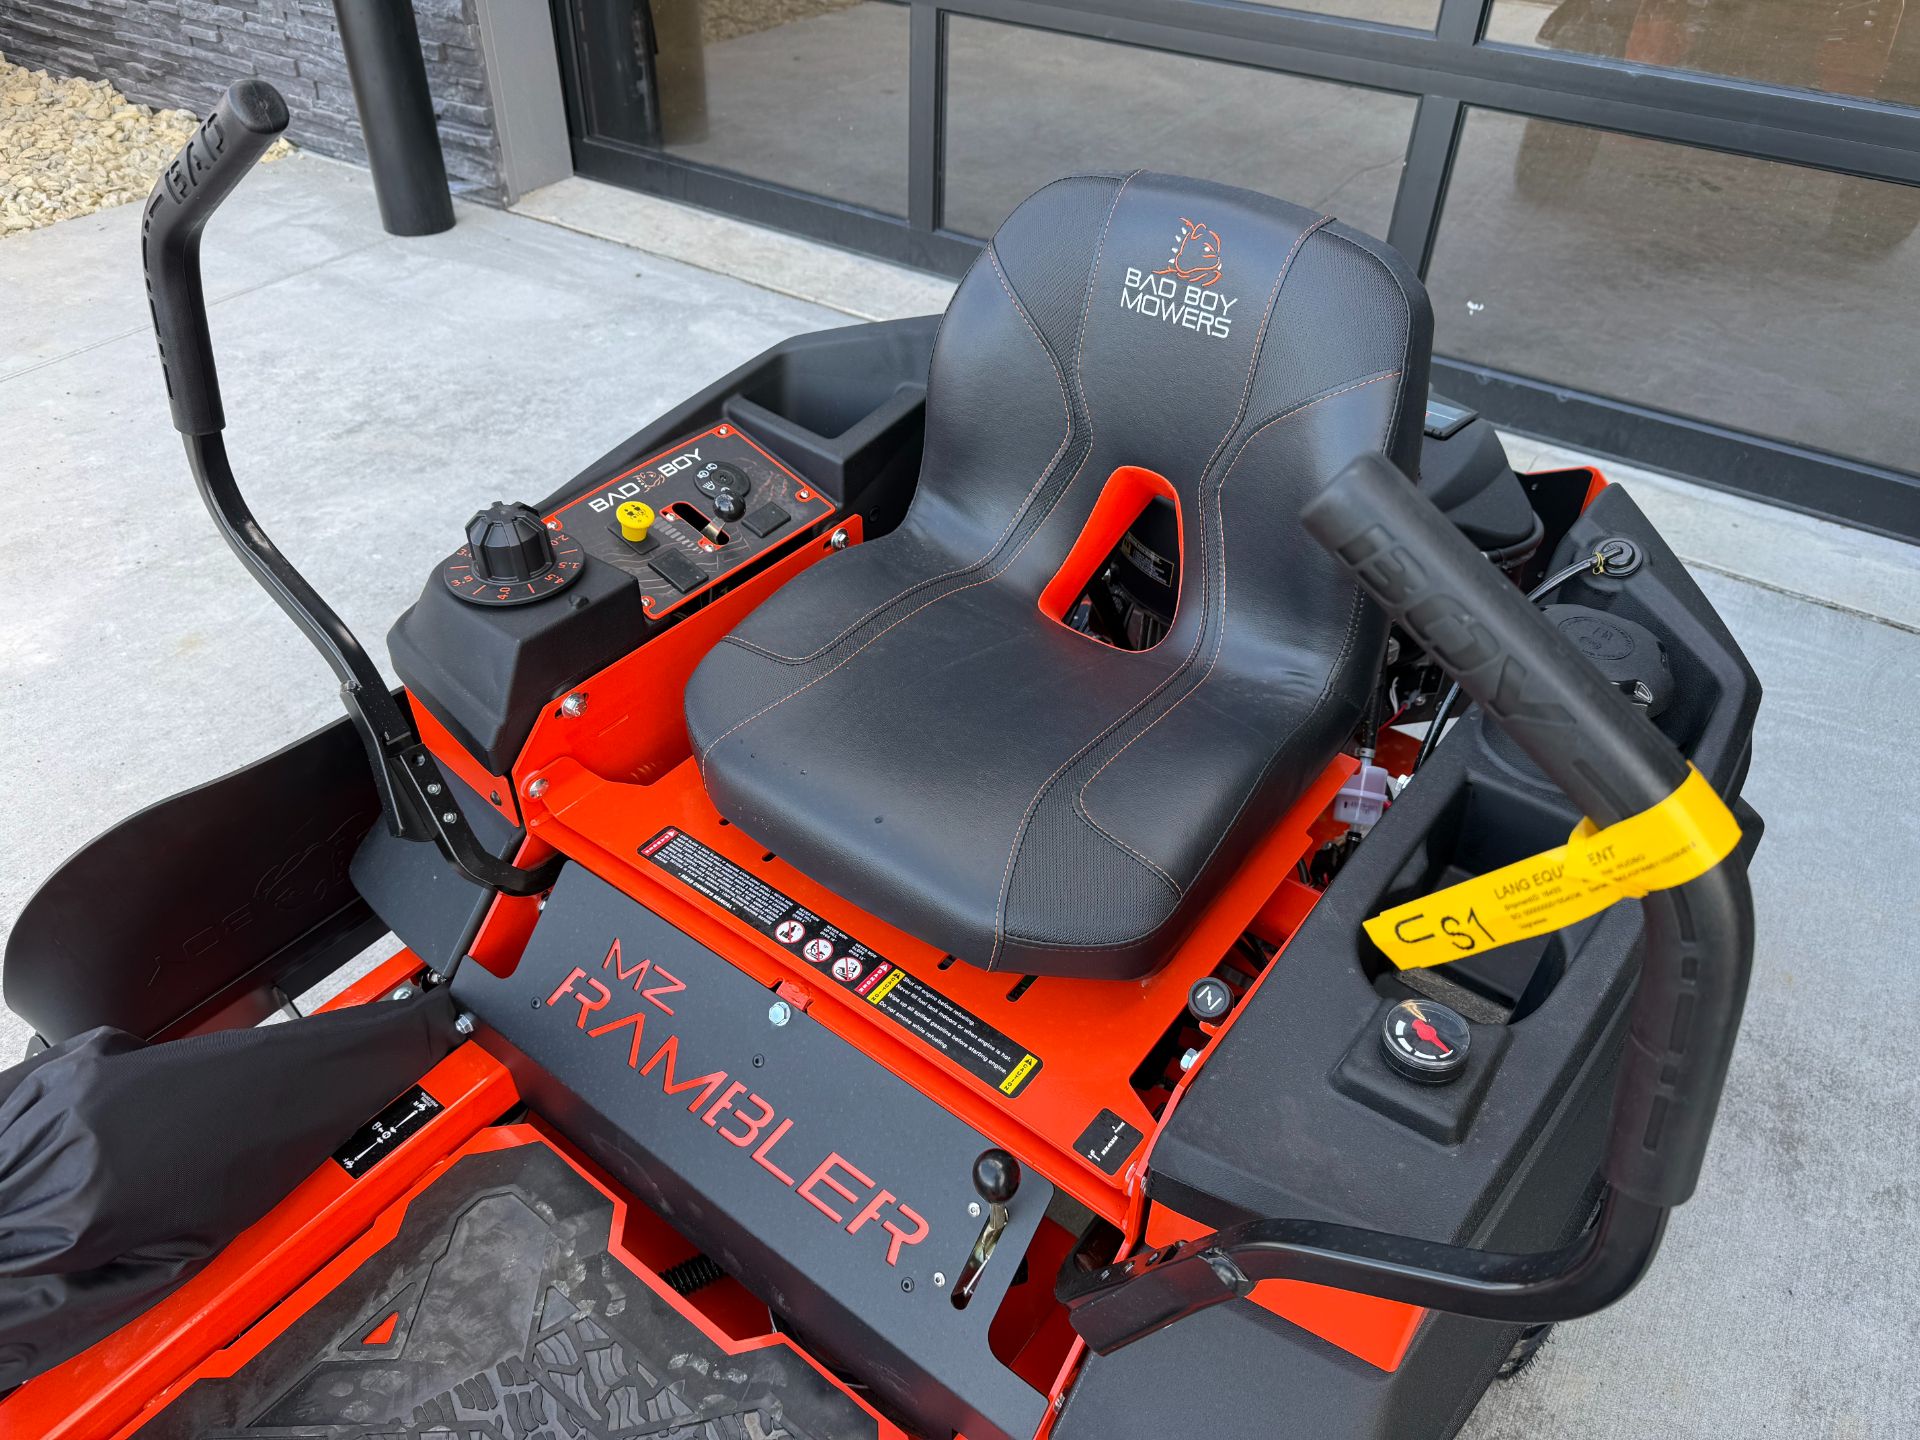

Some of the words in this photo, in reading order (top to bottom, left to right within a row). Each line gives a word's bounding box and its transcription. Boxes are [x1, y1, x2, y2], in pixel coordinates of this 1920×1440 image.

[1120, 287, 1232, 339] MOWERS
[1124, 266, 1177, 299] BAD
[1184, 285, 1238, 316] BOY
[588, 482, 641, 513] BAD
[658, 448, 702, 478] BOY
[1492, 878, 1531, 901] LANG
[602, 936, 687, 1017] MZ
[859, 970, 882, 993] DANGER
[871, 977, 896, 1001] CAUTION
[903, 977, 915, 986] Shut
[921, 989, 938, 1001] engine
[937, 999, 953, 1011] before
[887, 1005, 896, 1014] not
[895, 1012, 912, 1025] smoke
[911, 1022, 926, 1034] while
[888, 992, 900, 1003] Wipe
[914, 1010, 931, 1023] spilled
[930, 1021, 951, 1037] gasoline
[951, 1034, 968, 1048] before
[968, 1046, 988, 1062] starting
[896, 984, 911, 995] Never
[917, 997, 927, 1006] fuel
[926, 1004, 938, 1013] tank
[964, 1029, 978, 1039] when
[978, 1038, 995, 1051] engine
[1004, 1064, 1028, 1091] CAUTION
[545, 966, 931, 1268] RAMBLER
